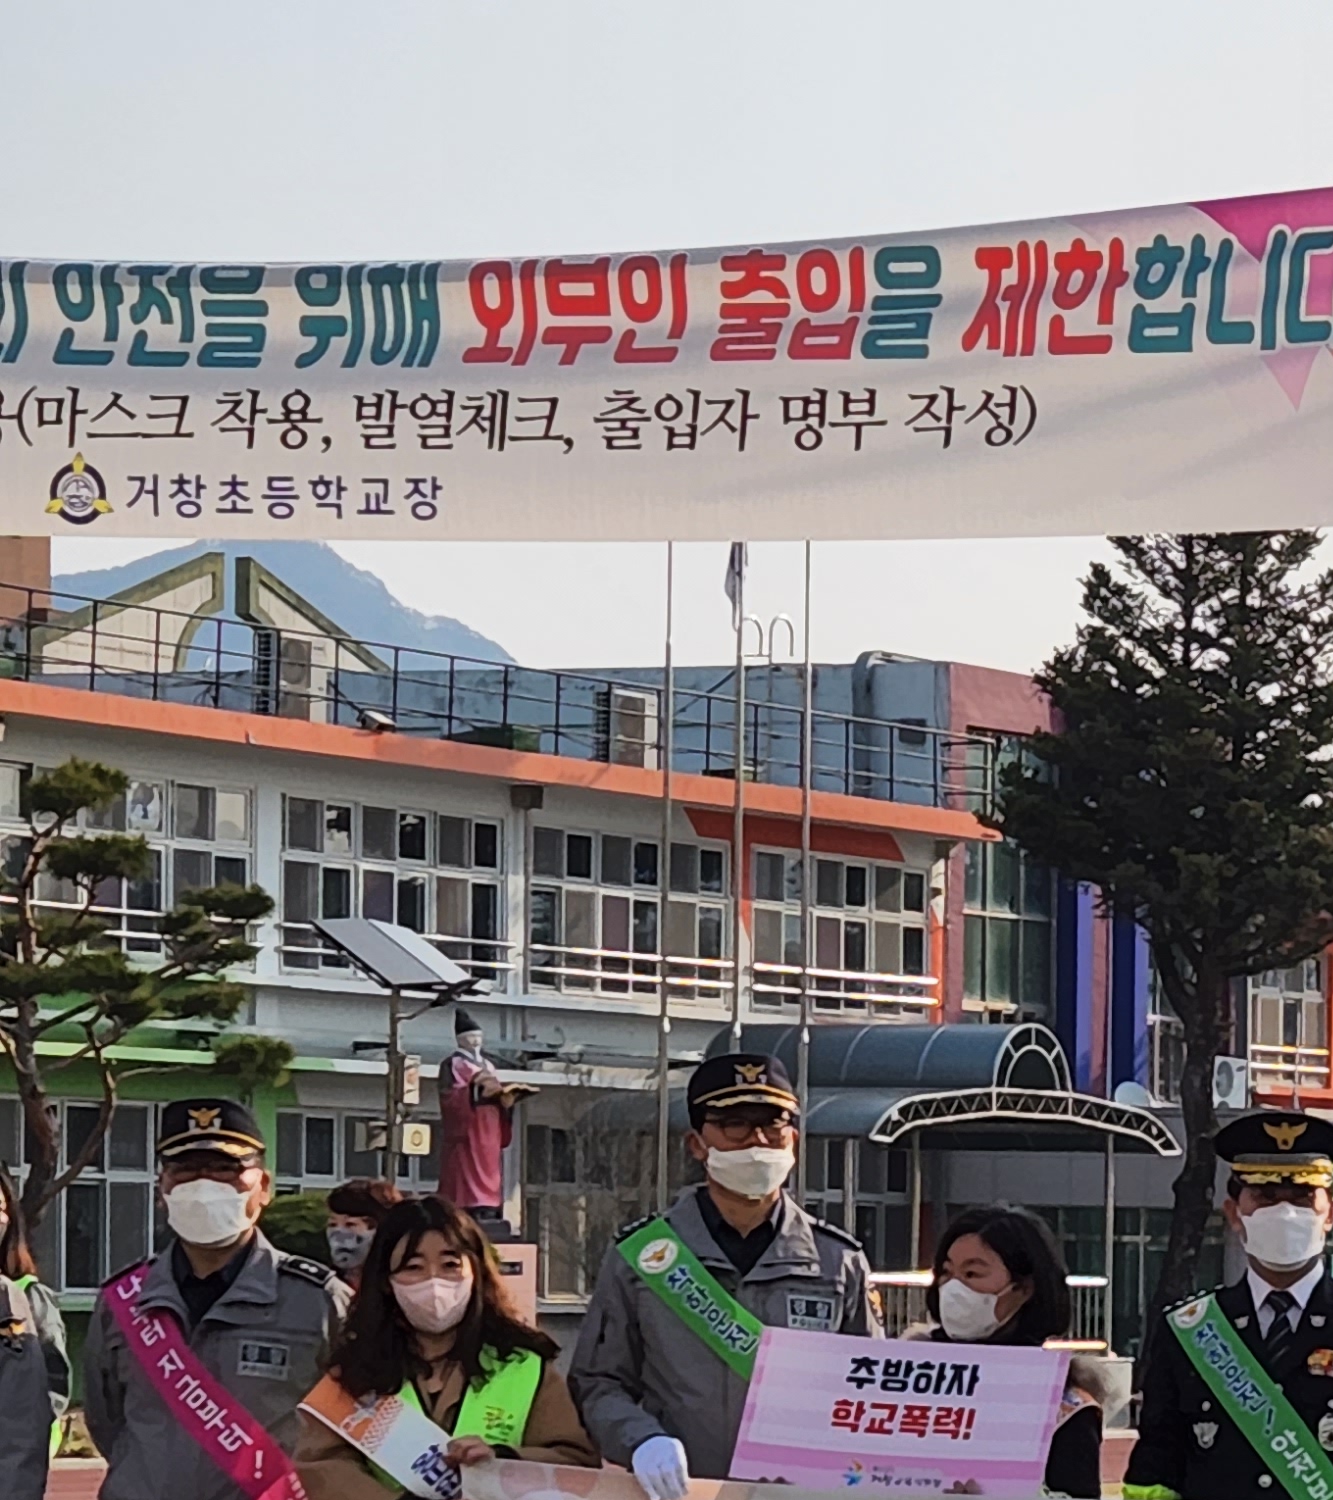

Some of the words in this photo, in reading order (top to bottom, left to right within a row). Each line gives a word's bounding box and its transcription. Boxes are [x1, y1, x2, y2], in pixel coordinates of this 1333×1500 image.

[52, 262, 268, 370] 안전을
[294, 261, 442, 370] 위해
[462, 253, 690, 367] 외부인
[709, 243, 943, 366] 출입을
[0, 384, 196, 449] (마스크
[209, 387, 333, 453] 착용,
[354, 388, 575, 454] 발열체크,
[593, 387, 762, 453] 출입자
[779, 386, 888, 453] 명부
[904, 383, 1039, 450] 작성)
[126, 472, 444, 521] 거창초등학교장
[665, 1266, 758, 1353] 착한운전
[156, 1348, 254, 1453] 지금부터
[846, 1356, 980, 1397] 추방하자
[831, 1399, 977, 1441] 학교폭력!
